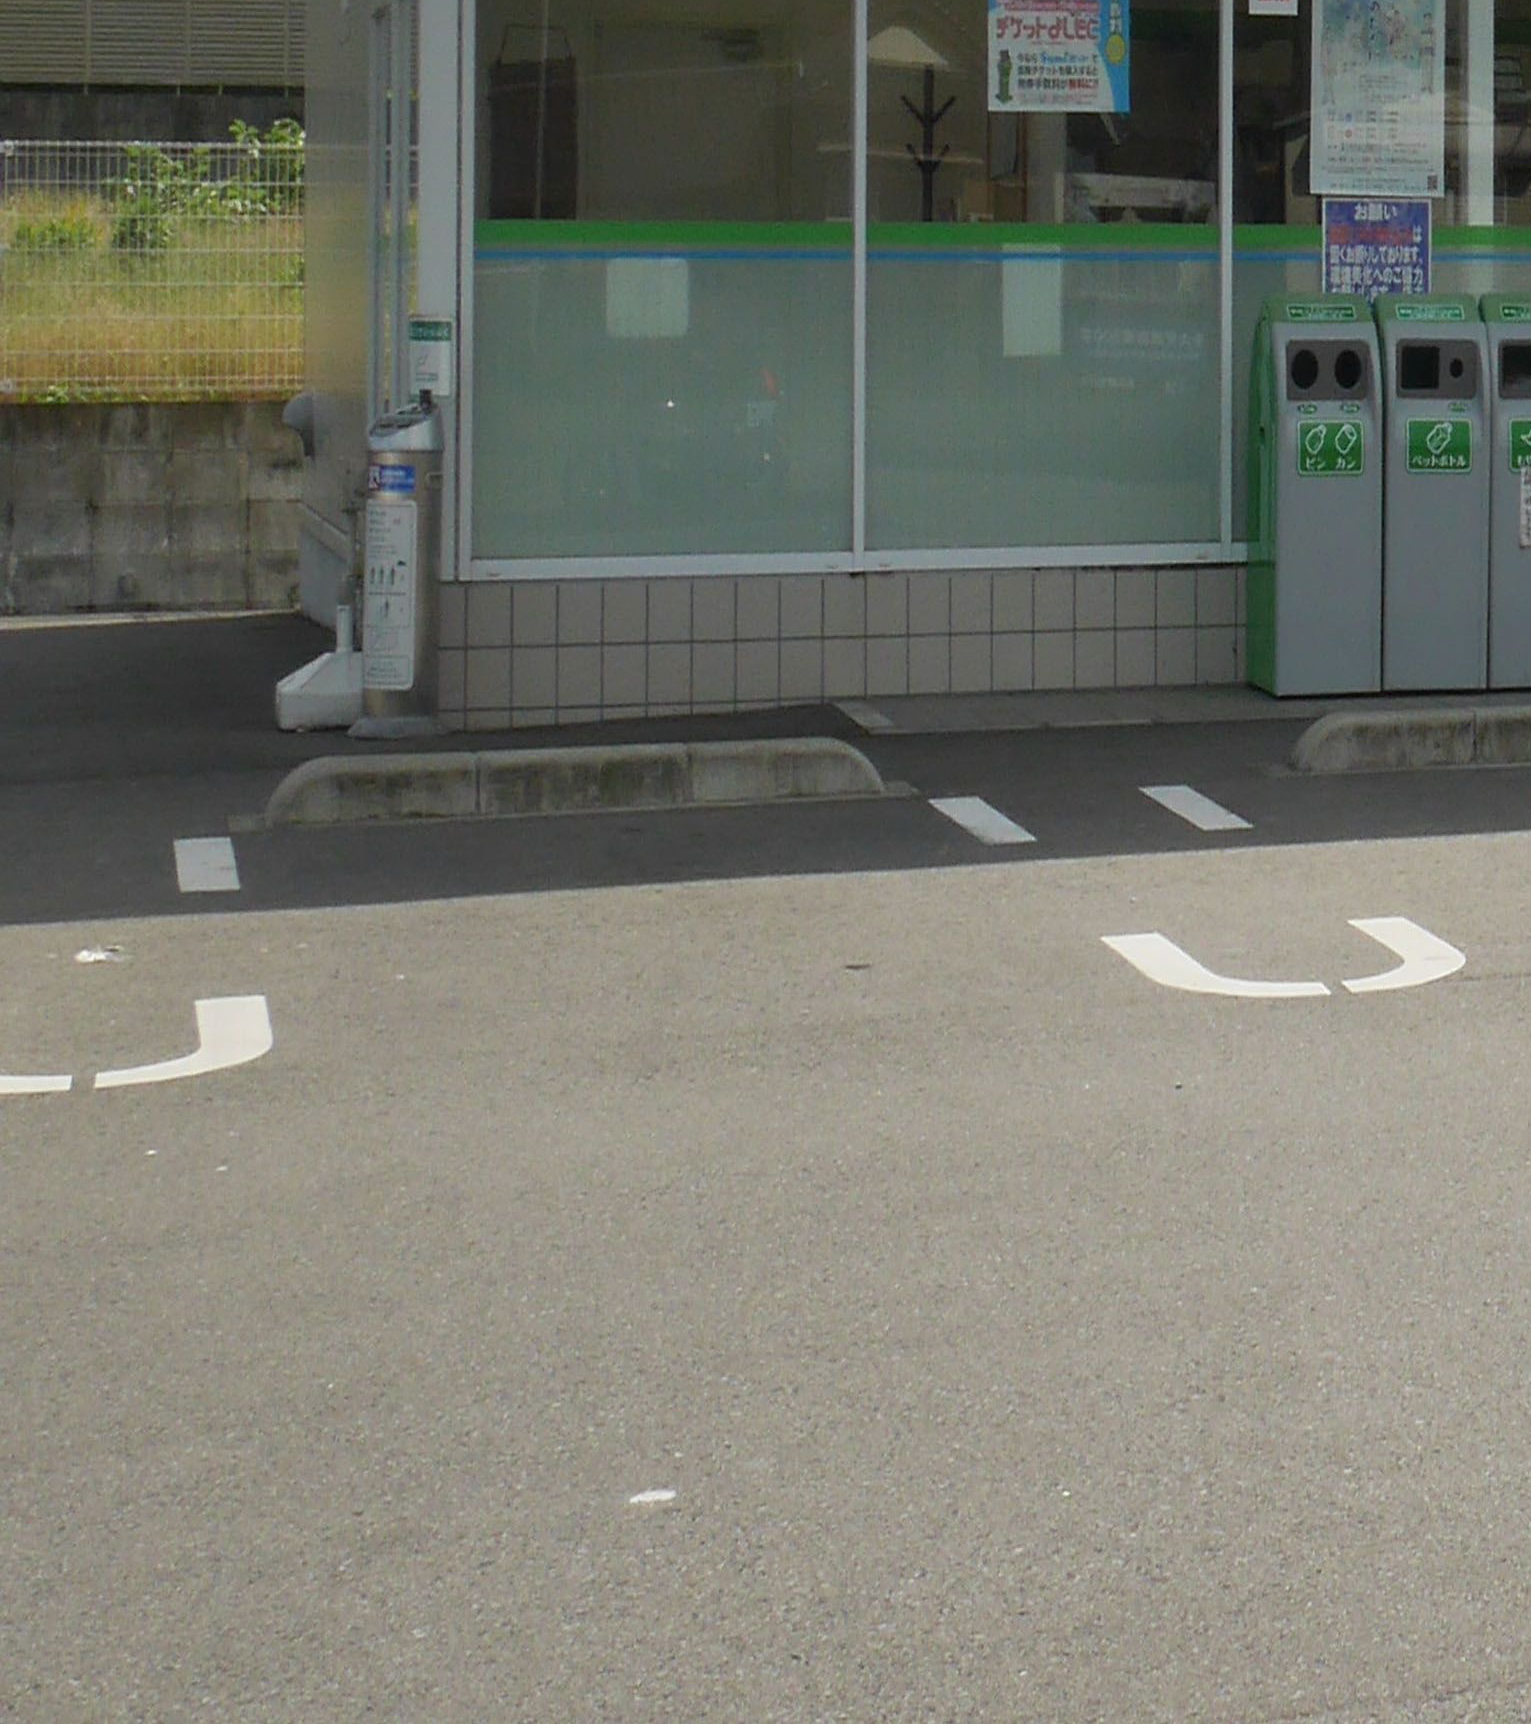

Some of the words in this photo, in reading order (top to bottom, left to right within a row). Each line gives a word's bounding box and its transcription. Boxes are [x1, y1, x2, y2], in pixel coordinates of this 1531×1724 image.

[1411, 455, 1467, 467] ペットボトル
